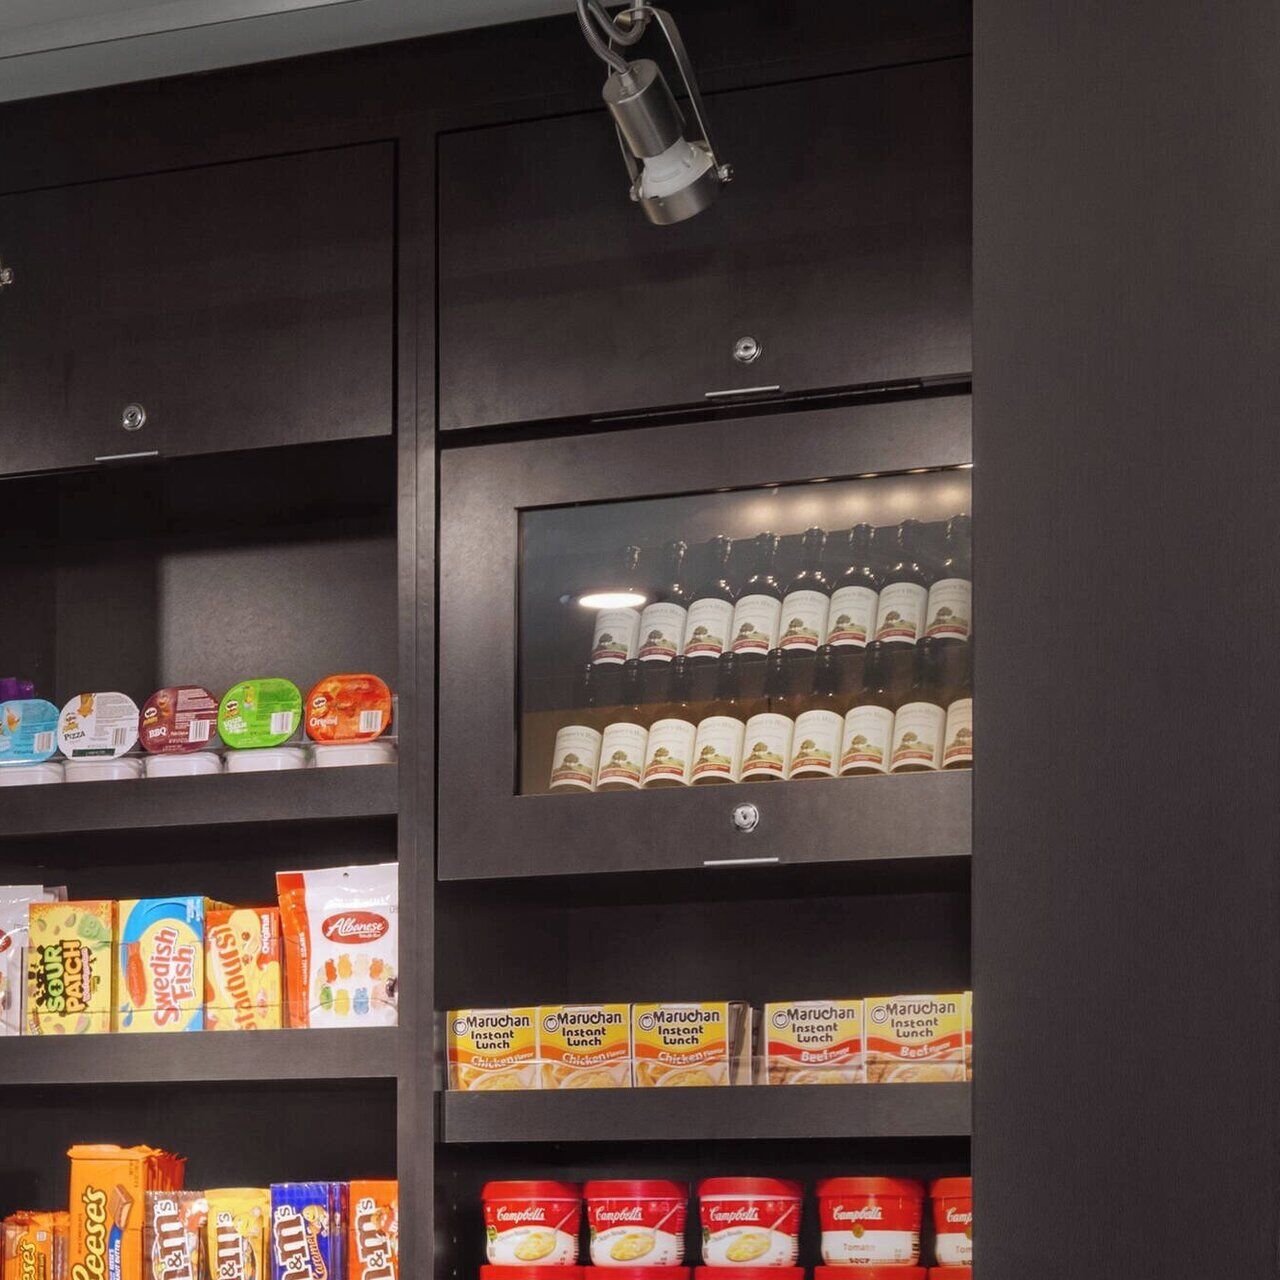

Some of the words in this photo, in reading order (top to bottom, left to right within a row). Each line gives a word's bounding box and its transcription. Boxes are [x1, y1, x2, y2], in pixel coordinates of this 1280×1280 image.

[148, 726, 167, 738] BBQ
[328, 917, 384, 937] Albanese
[46, 945, 64, 1012] SOUR
[64, 938, 86, 1013] PATCH
[153, 927, 178, 1026] Swedish
[172, 945, 194, 1001] Fish
[788, 1008, 854, 1021] Maruchan
[887, 1002, 955, 1016] Maruchan
[468, 1016, 529, 1028] Maruchan
[558, 1012, 622, 1026] Maruchan
[653, 1009, 720, 1023] Maruchan
[792, 1023, 838, 1033] Instant
[891, 1018, 939, 1028] Instant
[471, 1030, 514, 1040] Instant
[562, 1028, 606, 1037] Instant
[658, 1026, 704, 1036] Instant
[896, 1028, 933, 1038] Lunch
[568, 1036, 602, 1046] Lunch
[663, 1035, 699, 1045] Lunch
[798, 1033, 833, 1043] Lunch
[476, 1040, 510, 1049] Lunch
[801, 1050, 828, 1062] Beef
[900, 1046, 929, 1057] Beef
[562, 1053, 606, 1064] Chicken
[658, 1052, 702, 1064] Chicken
